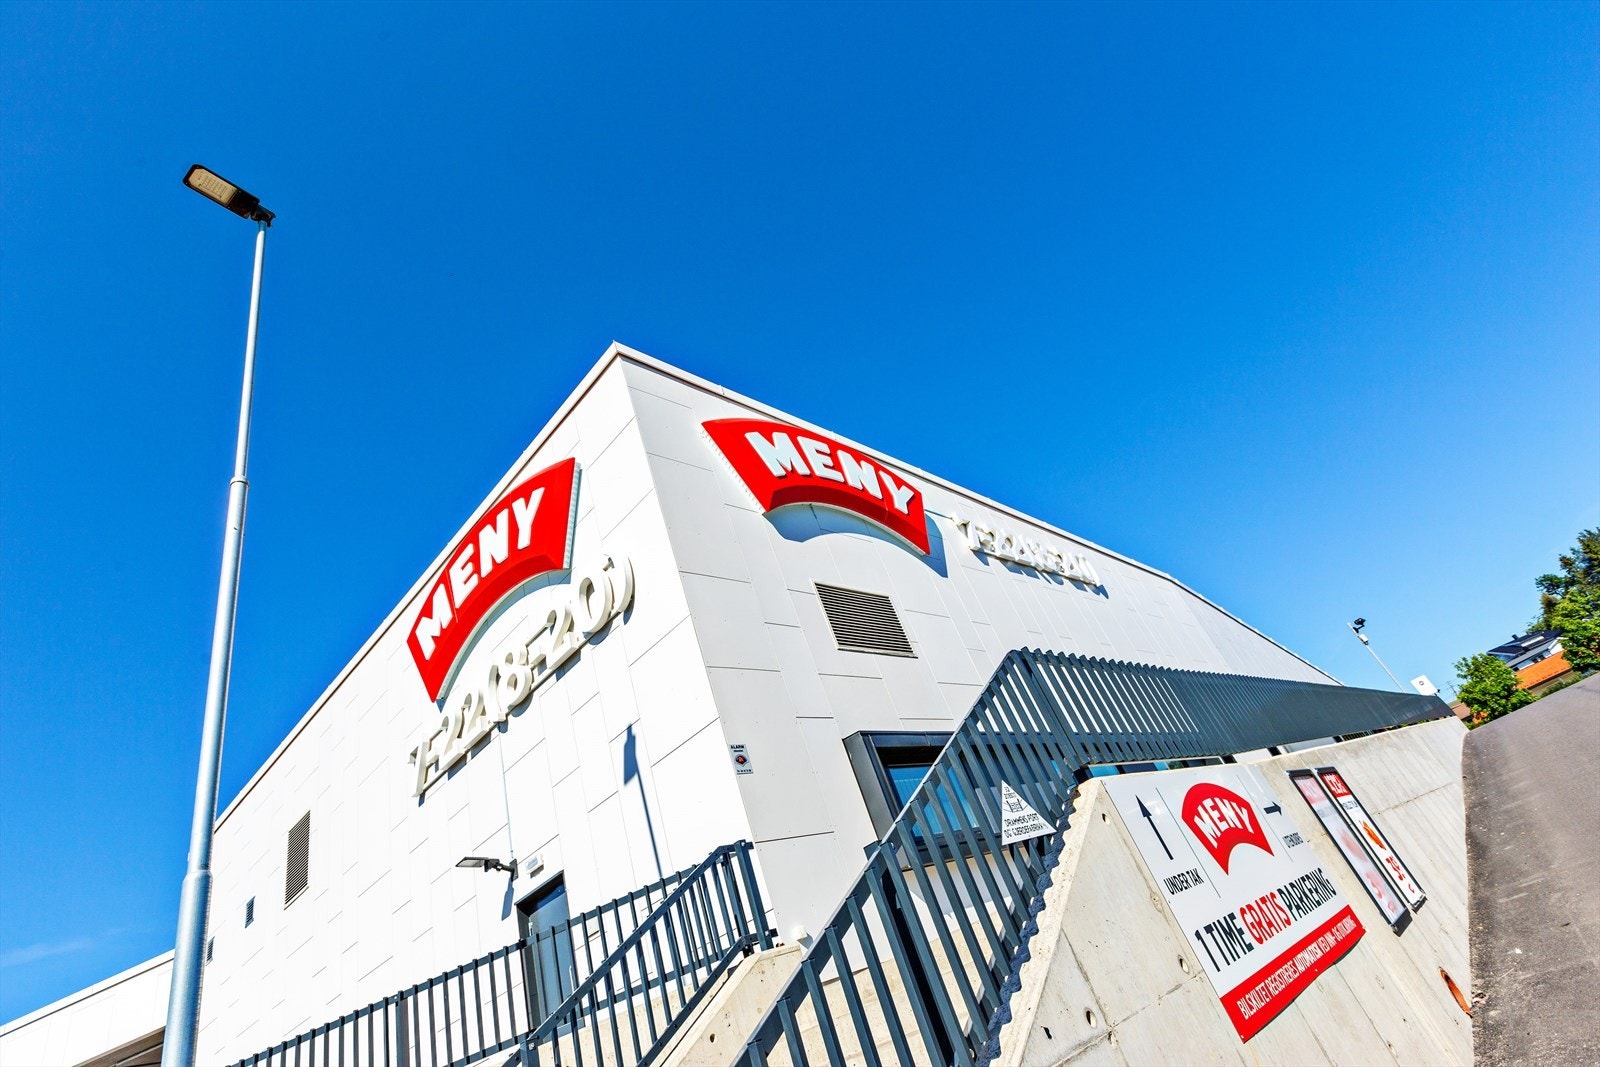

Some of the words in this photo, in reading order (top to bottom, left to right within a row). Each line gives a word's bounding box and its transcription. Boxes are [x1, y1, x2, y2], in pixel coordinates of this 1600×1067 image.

[744, 431, 915, 515] MENY
[414, 487, 546, 660] MENY
[1193, 797, 1254, 849] MENY
[1163, 872, 1192, 895] UNDER
[1186, 868, 1204, 886] TAK
[1277, 868, 1337, 922] PARKERING
[1203, 912, 1254, 966] TIME
[1239, 892, 1291, 945] GRATIS
[1194, 929, 1221, 973] 1
[1236, 982, 1272, 1020] BILSKILTET
[1265, 960, 1300, 997] REGISTRERES
